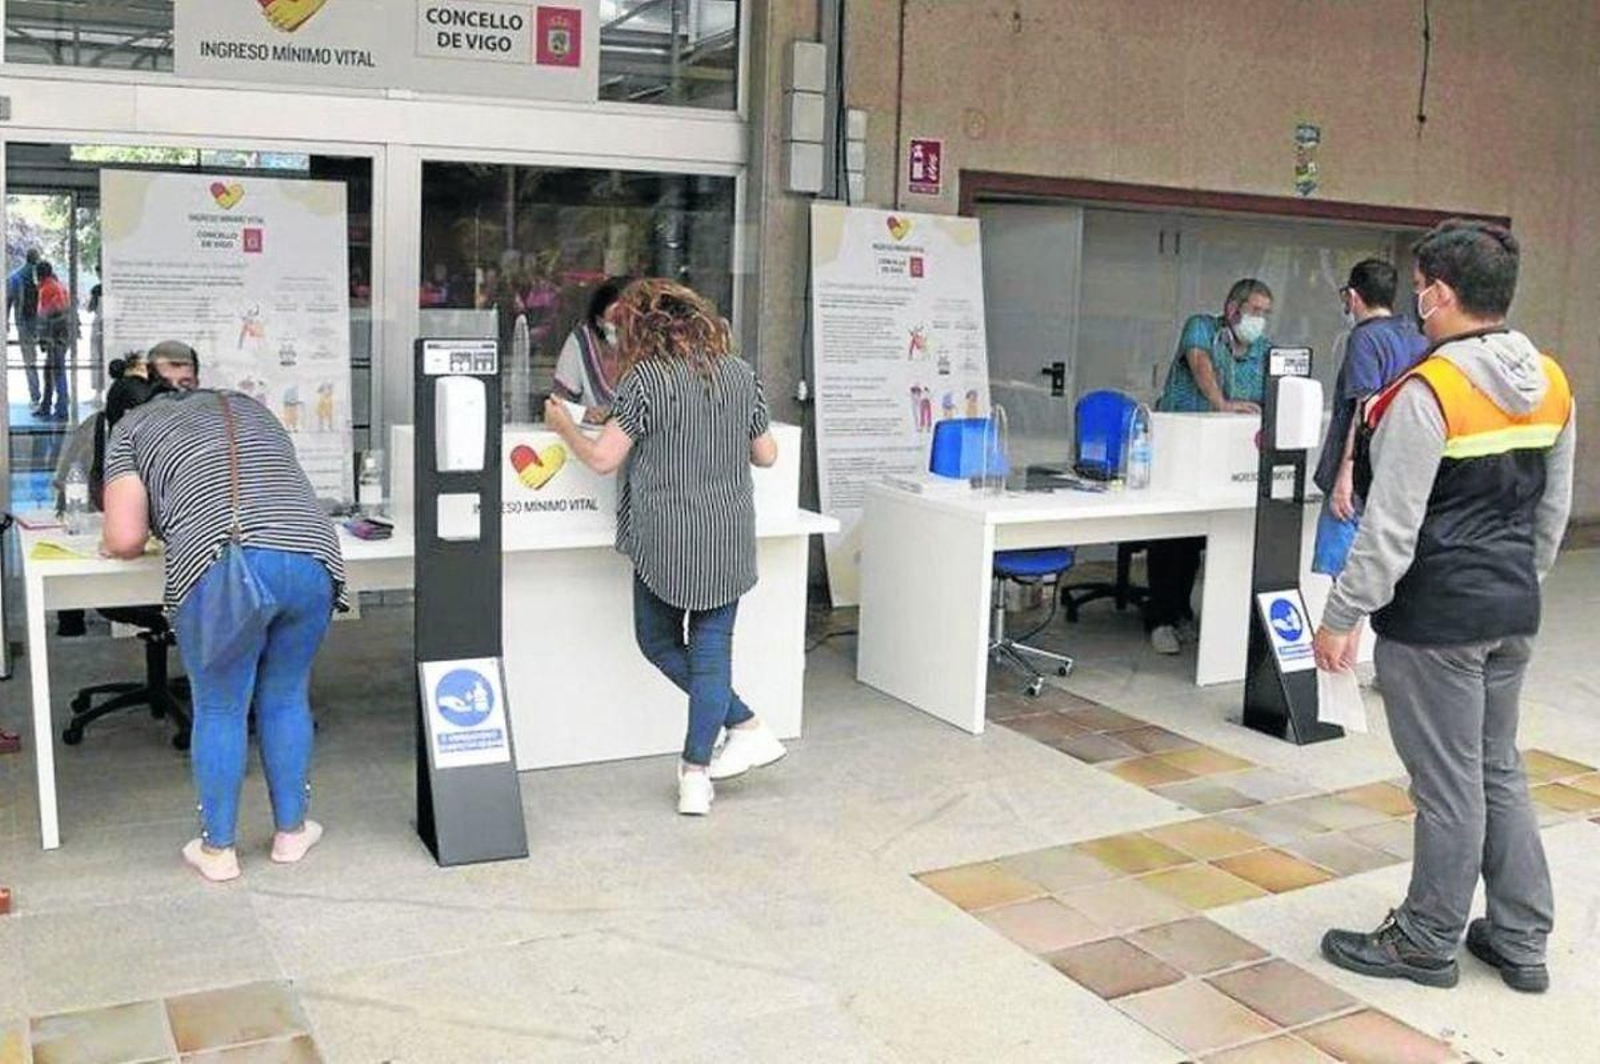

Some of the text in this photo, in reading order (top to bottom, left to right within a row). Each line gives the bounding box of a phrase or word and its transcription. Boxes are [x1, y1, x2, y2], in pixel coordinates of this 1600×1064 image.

[426, 8, 523, 31] CONCELLO
[437, 31, 512, 52] DE VIGO
[200, 41, 376, 68] INGRESO MÍNIMO VITAL
[569, 497, 598, 511] VITAL
